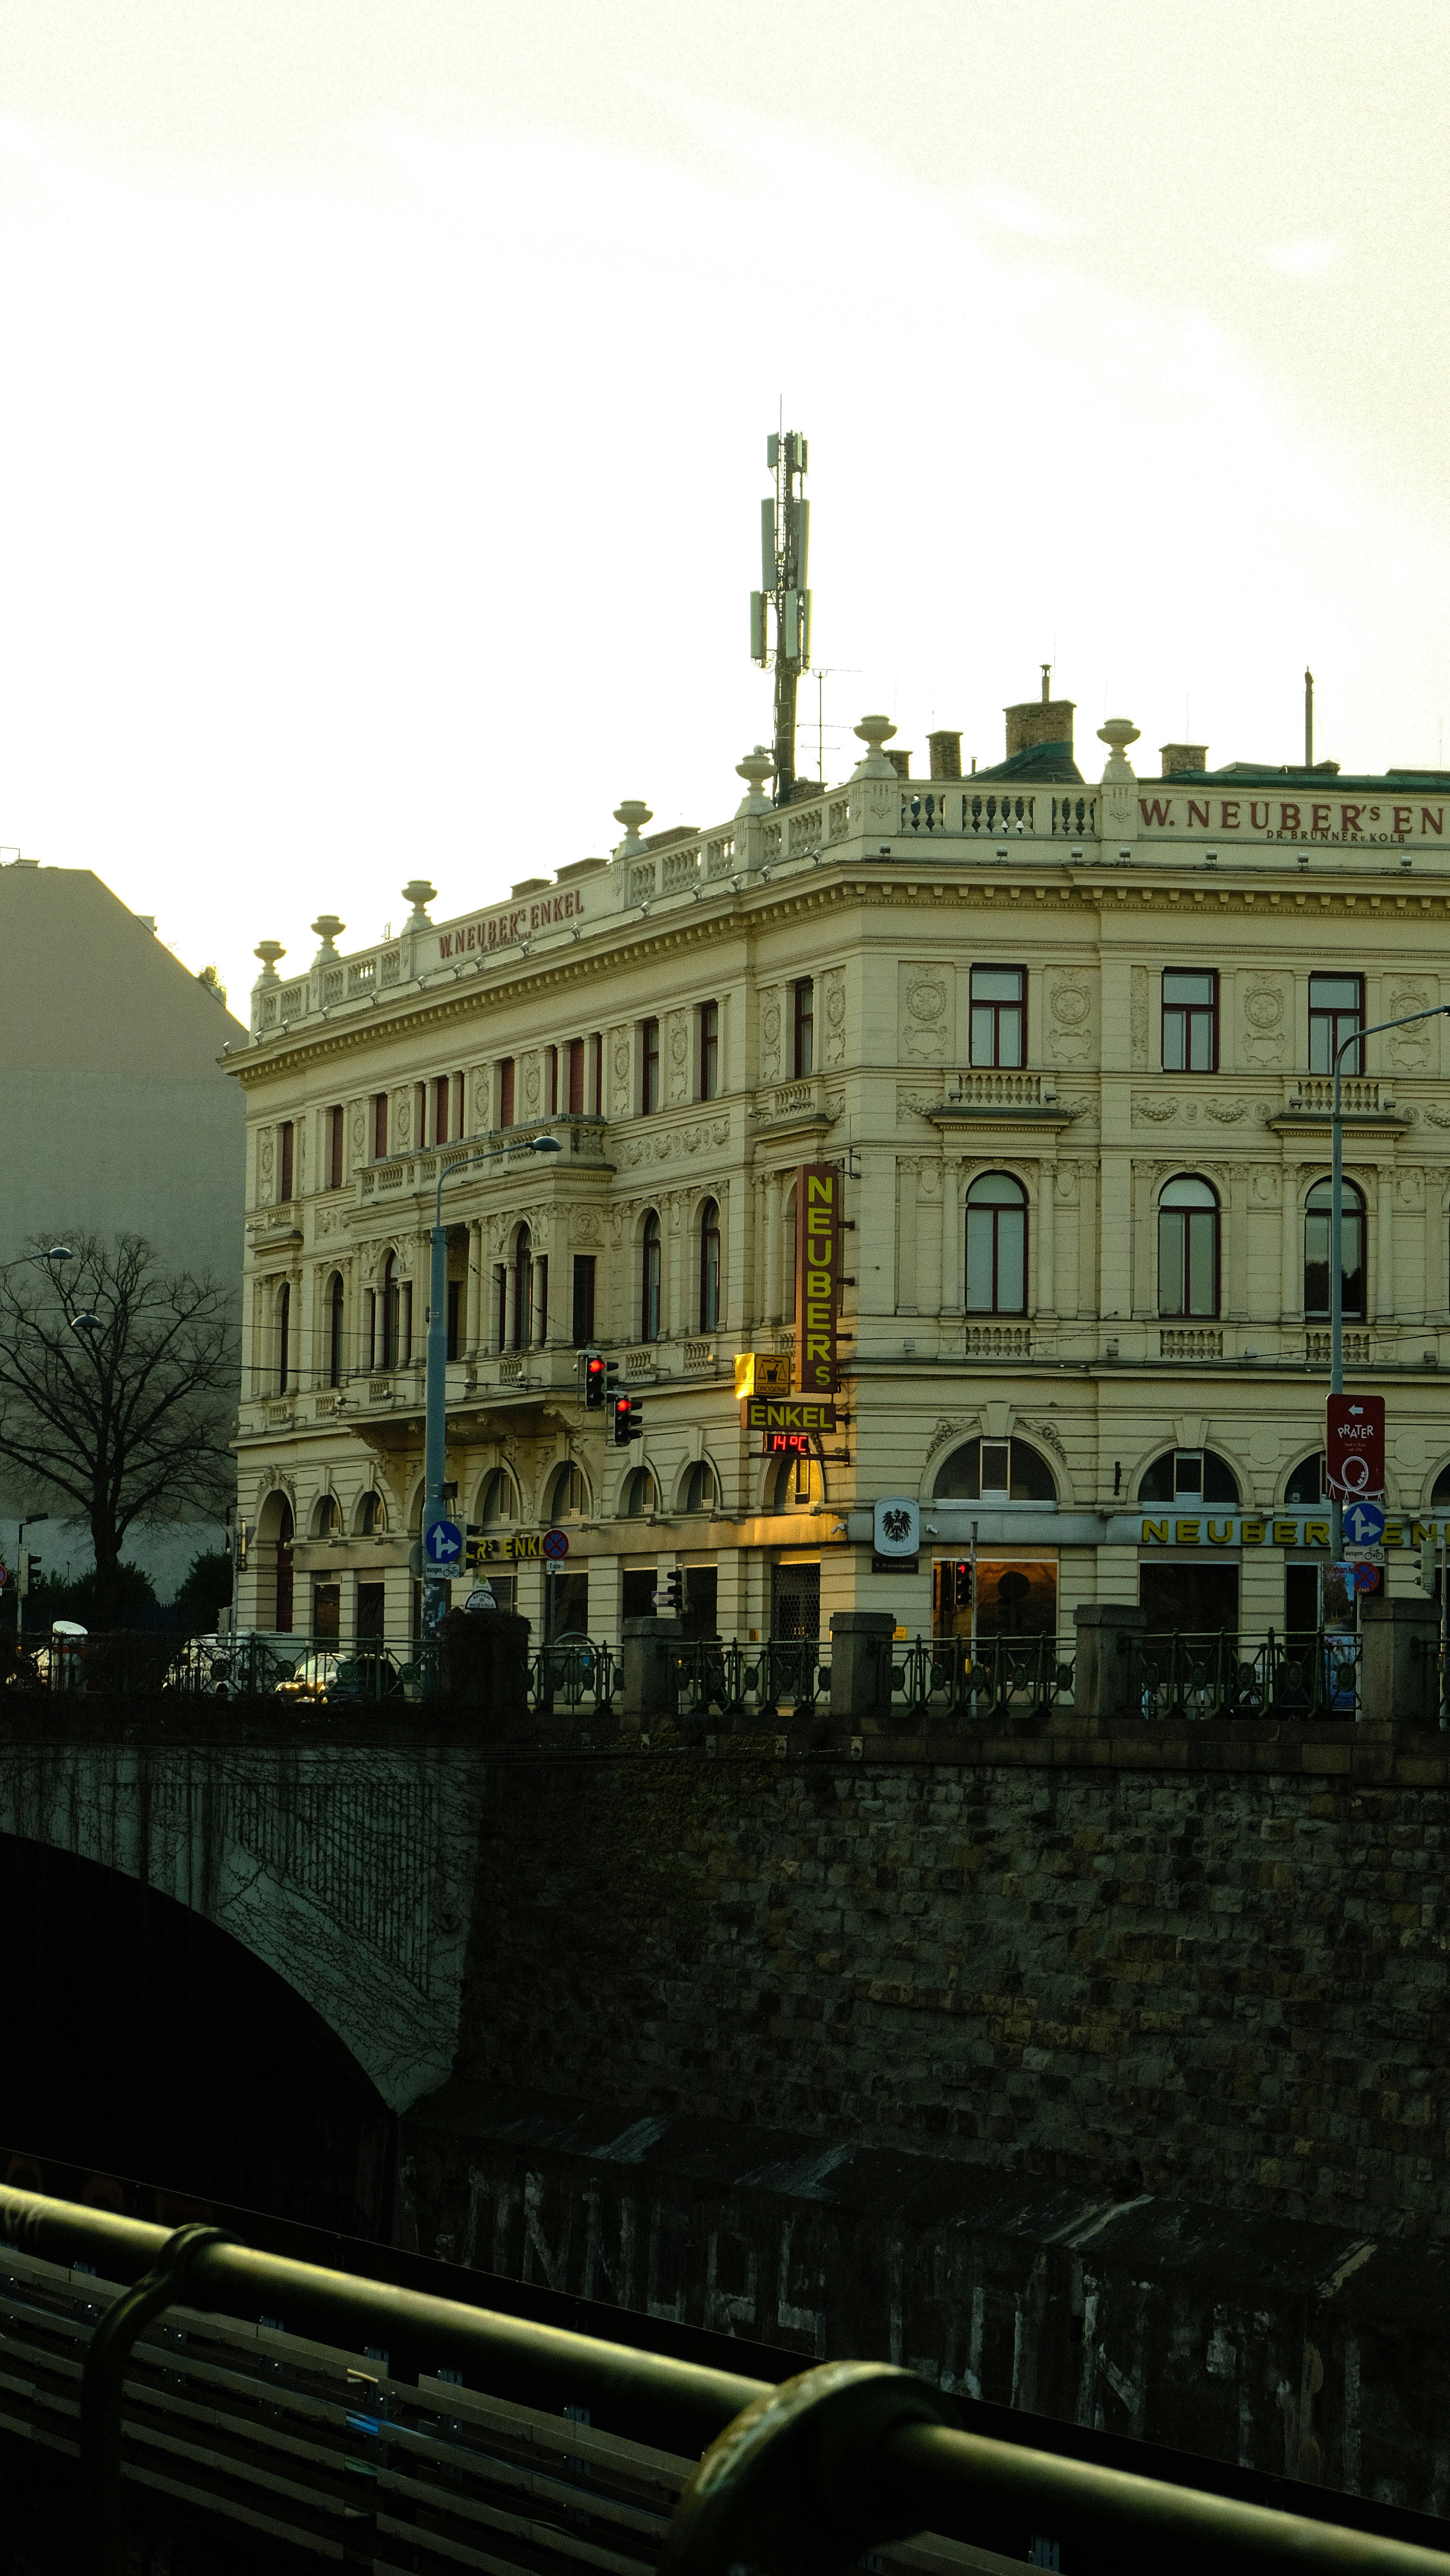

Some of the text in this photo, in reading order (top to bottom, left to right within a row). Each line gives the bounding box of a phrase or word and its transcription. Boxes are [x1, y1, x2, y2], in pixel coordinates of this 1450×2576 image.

[1138, 798, 1175, 826] W.
[1267, 830, 1287, 839] DR.
[1291, 831, 1358, 842] BRUNNER
[1370, 833, 1405, 843] KOLB
[530, 889, 584, 930] ENKEL
[750, 1404, 834, 1428] ENKEL
[1337, 1424, 1374, 1439] PRATER
